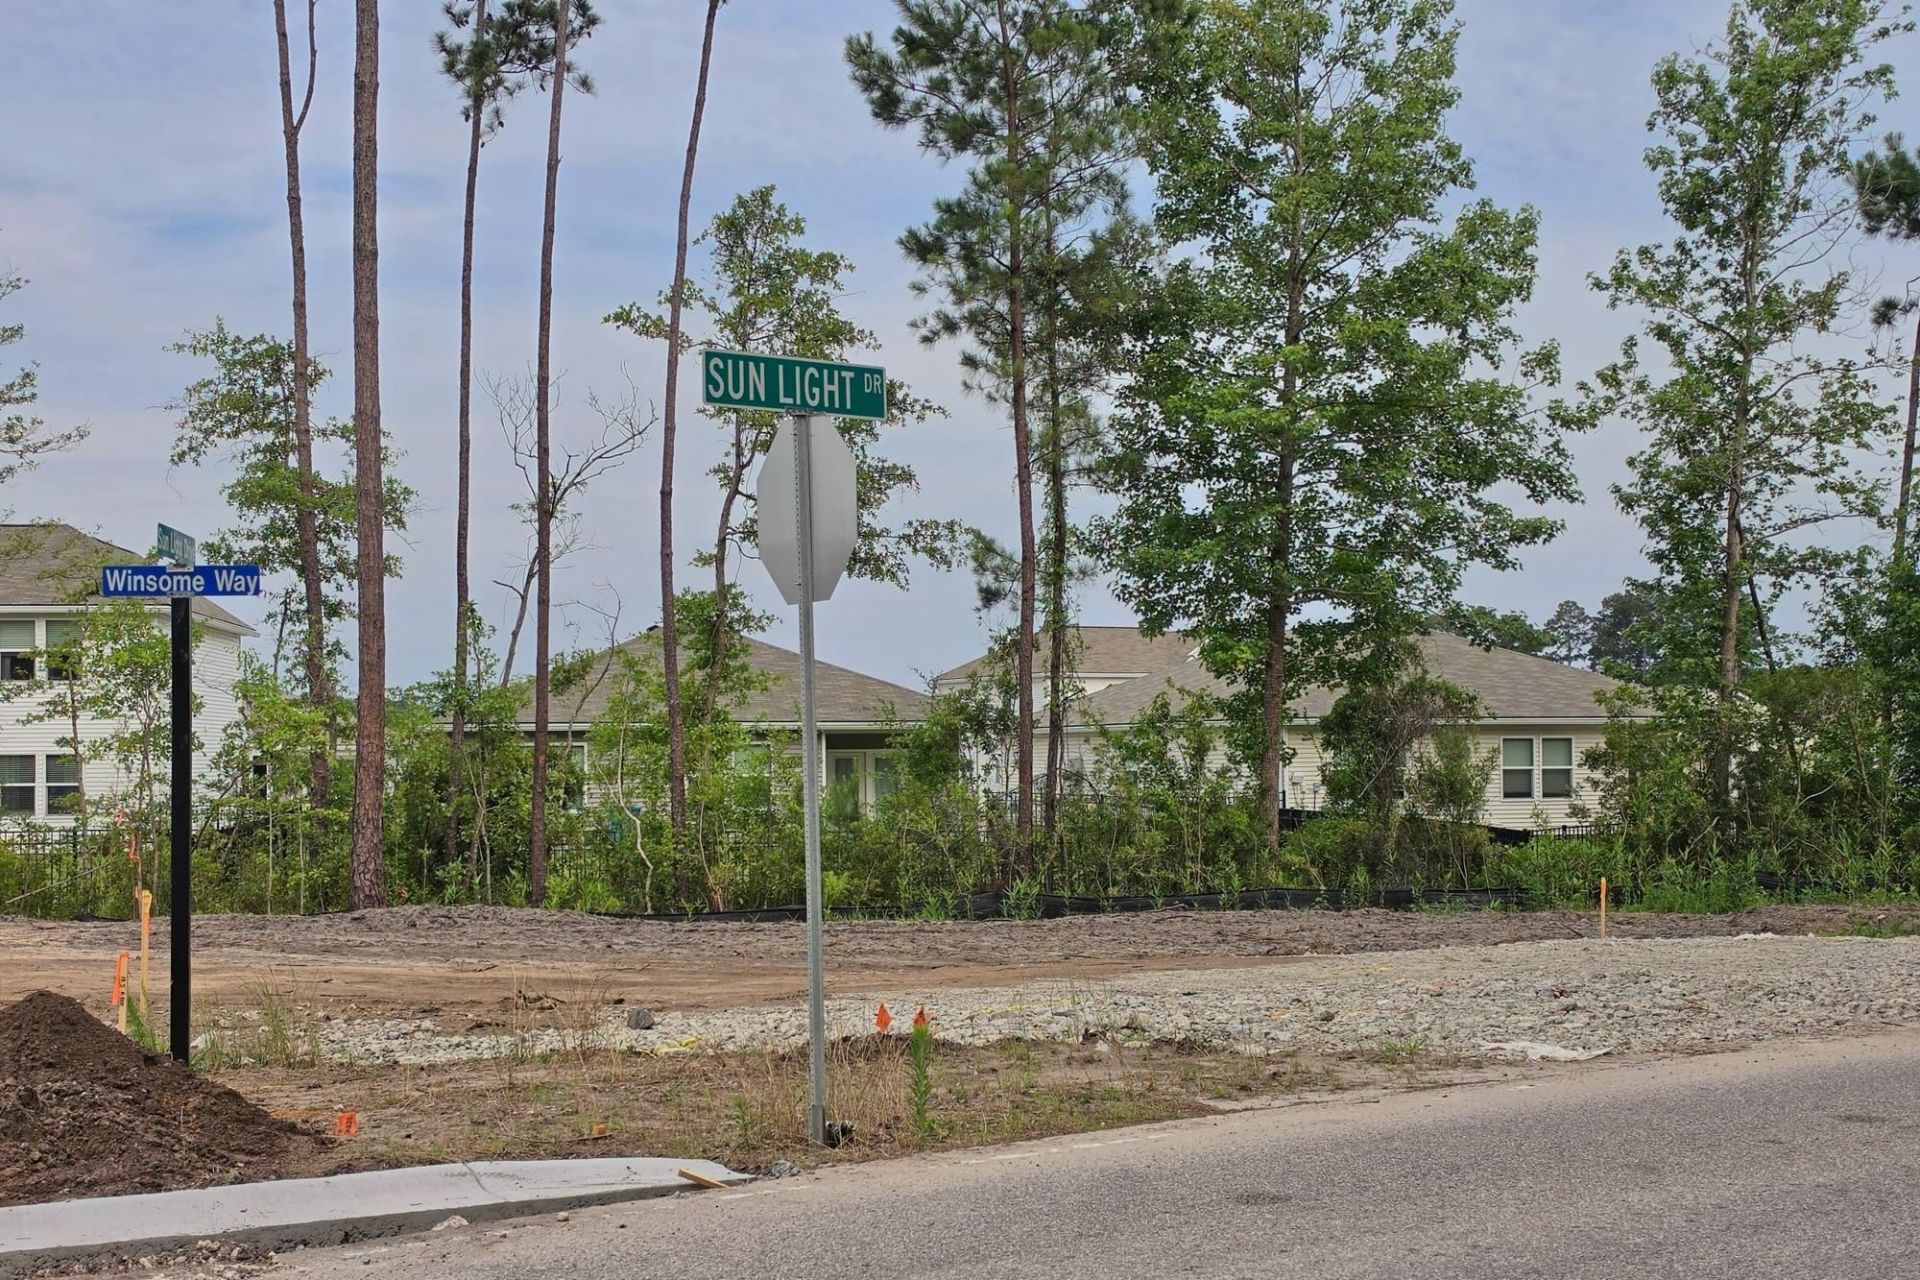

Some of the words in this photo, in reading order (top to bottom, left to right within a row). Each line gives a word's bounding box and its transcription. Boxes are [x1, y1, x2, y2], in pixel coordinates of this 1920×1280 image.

[708, 357, 766, 402] SUN
[778, 364, 855, 409] LIGHT
[864, 373, 882, 394] DR
[105, 569, 205, 592] Winsome
[214, 569, 259, 595] Way
